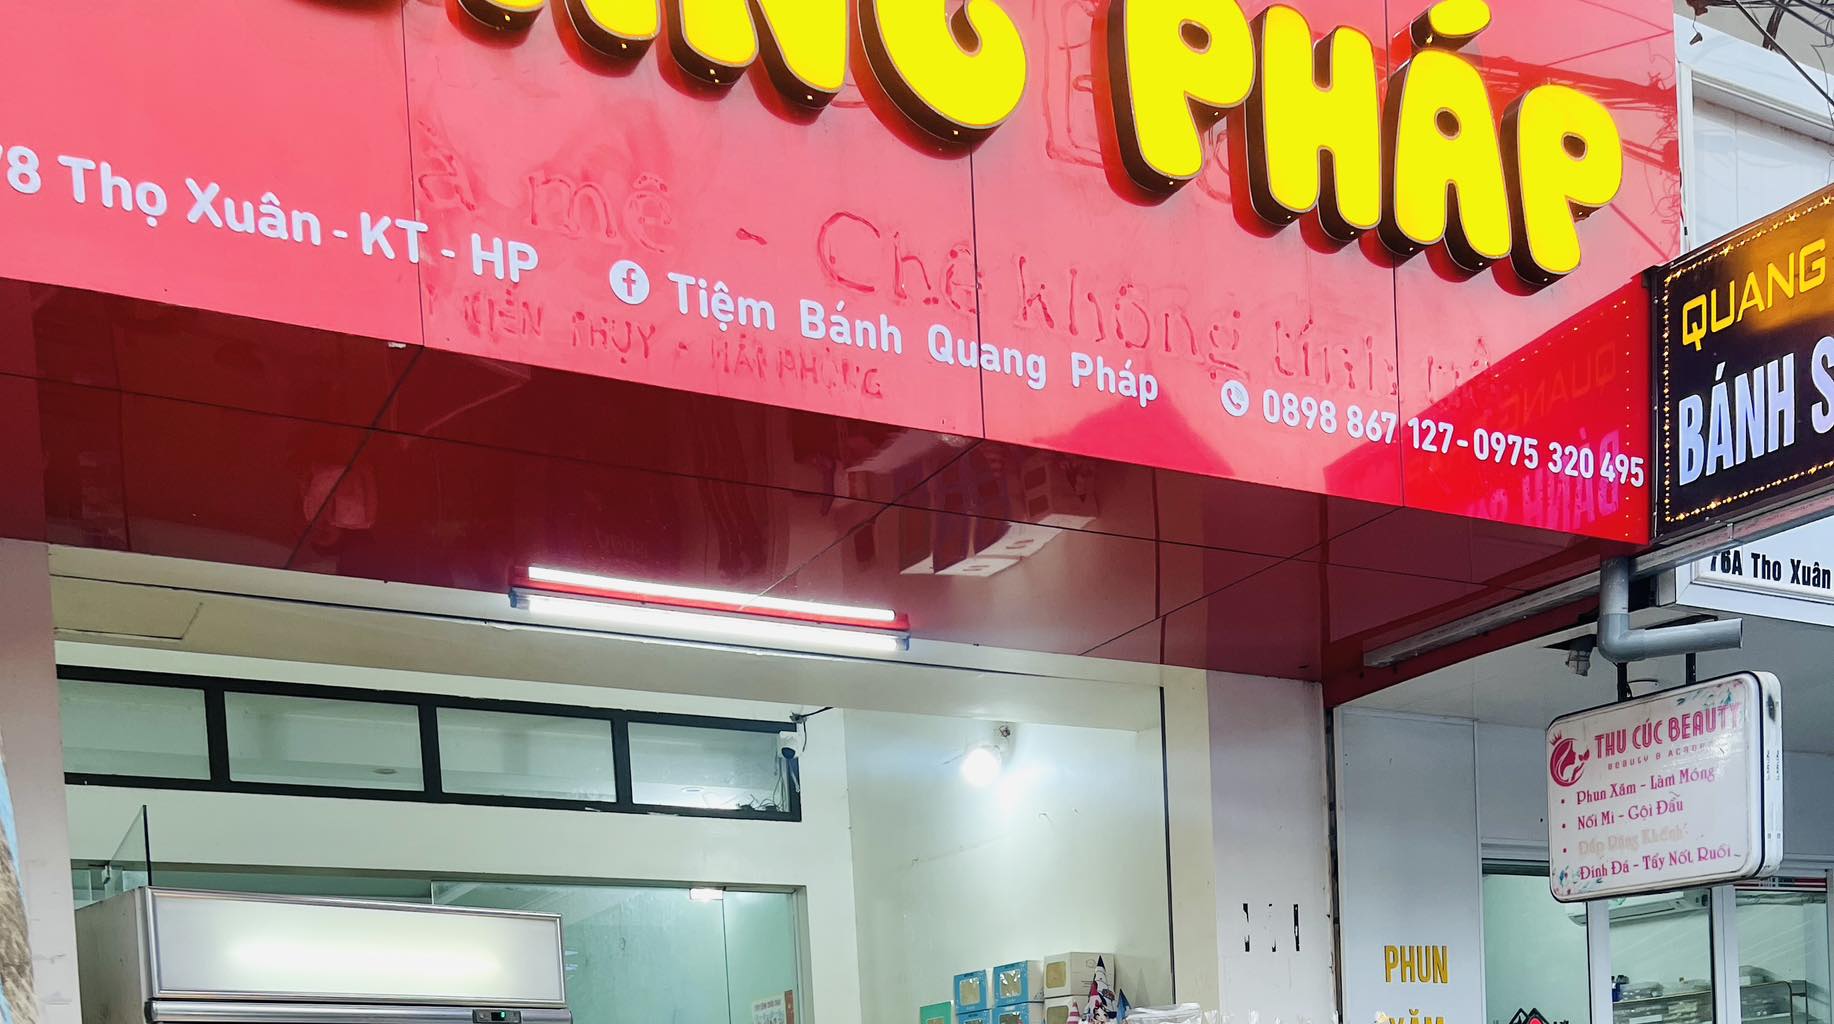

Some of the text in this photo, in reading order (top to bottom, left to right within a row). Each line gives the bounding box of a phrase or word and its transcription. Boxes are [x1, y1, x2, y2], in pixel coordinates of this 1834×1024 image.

[1112, 0, 1623, 276] PHÁP
[0, 145, 41, 194] 8
[57, 154, 167, 227] Thọ
[184, 175, 321, 246] Xuân
[360, 212, 428, 264] KT
[471, 232, 539, 283] HP
[1681, 238, 1826, 351] QUANG
[667, 270, 776, 332] Tiệm
[799, 298, 902, 355] Bánh
[927, 323, 1047, 390] Quang
[1071, 350, 1159, 408] Pháp
[1263, 388, 1338, 434] 0898
[1347, 405, 1397, 444] 867
[1548, 441, 1594, 478] 320
[1600, 452, 1645, 487] 495
[1678, 353, 1796, 486] BÁNH
[1751, 552, 1782, 581] Tho
[1790, 557, 1831, 589] Xuân
[1595, 703, 1741, 759] THU CÚC BEAUTY
[1576, 789, 1606, 805] Phun
[1650, 774, 1675, 790] Làm
[1679, 767, 1715, 784] Móng
[1577, 814, 1598, 830] Nối
[1601, 810, 1615, 826] Mi
[1628, 804, 1653, 821] Gội
[1580, 864, 1608, 880] Đính
[1611, 858, 1629, 875] Đá
[1384, 945, 1448, 984] PHUN
